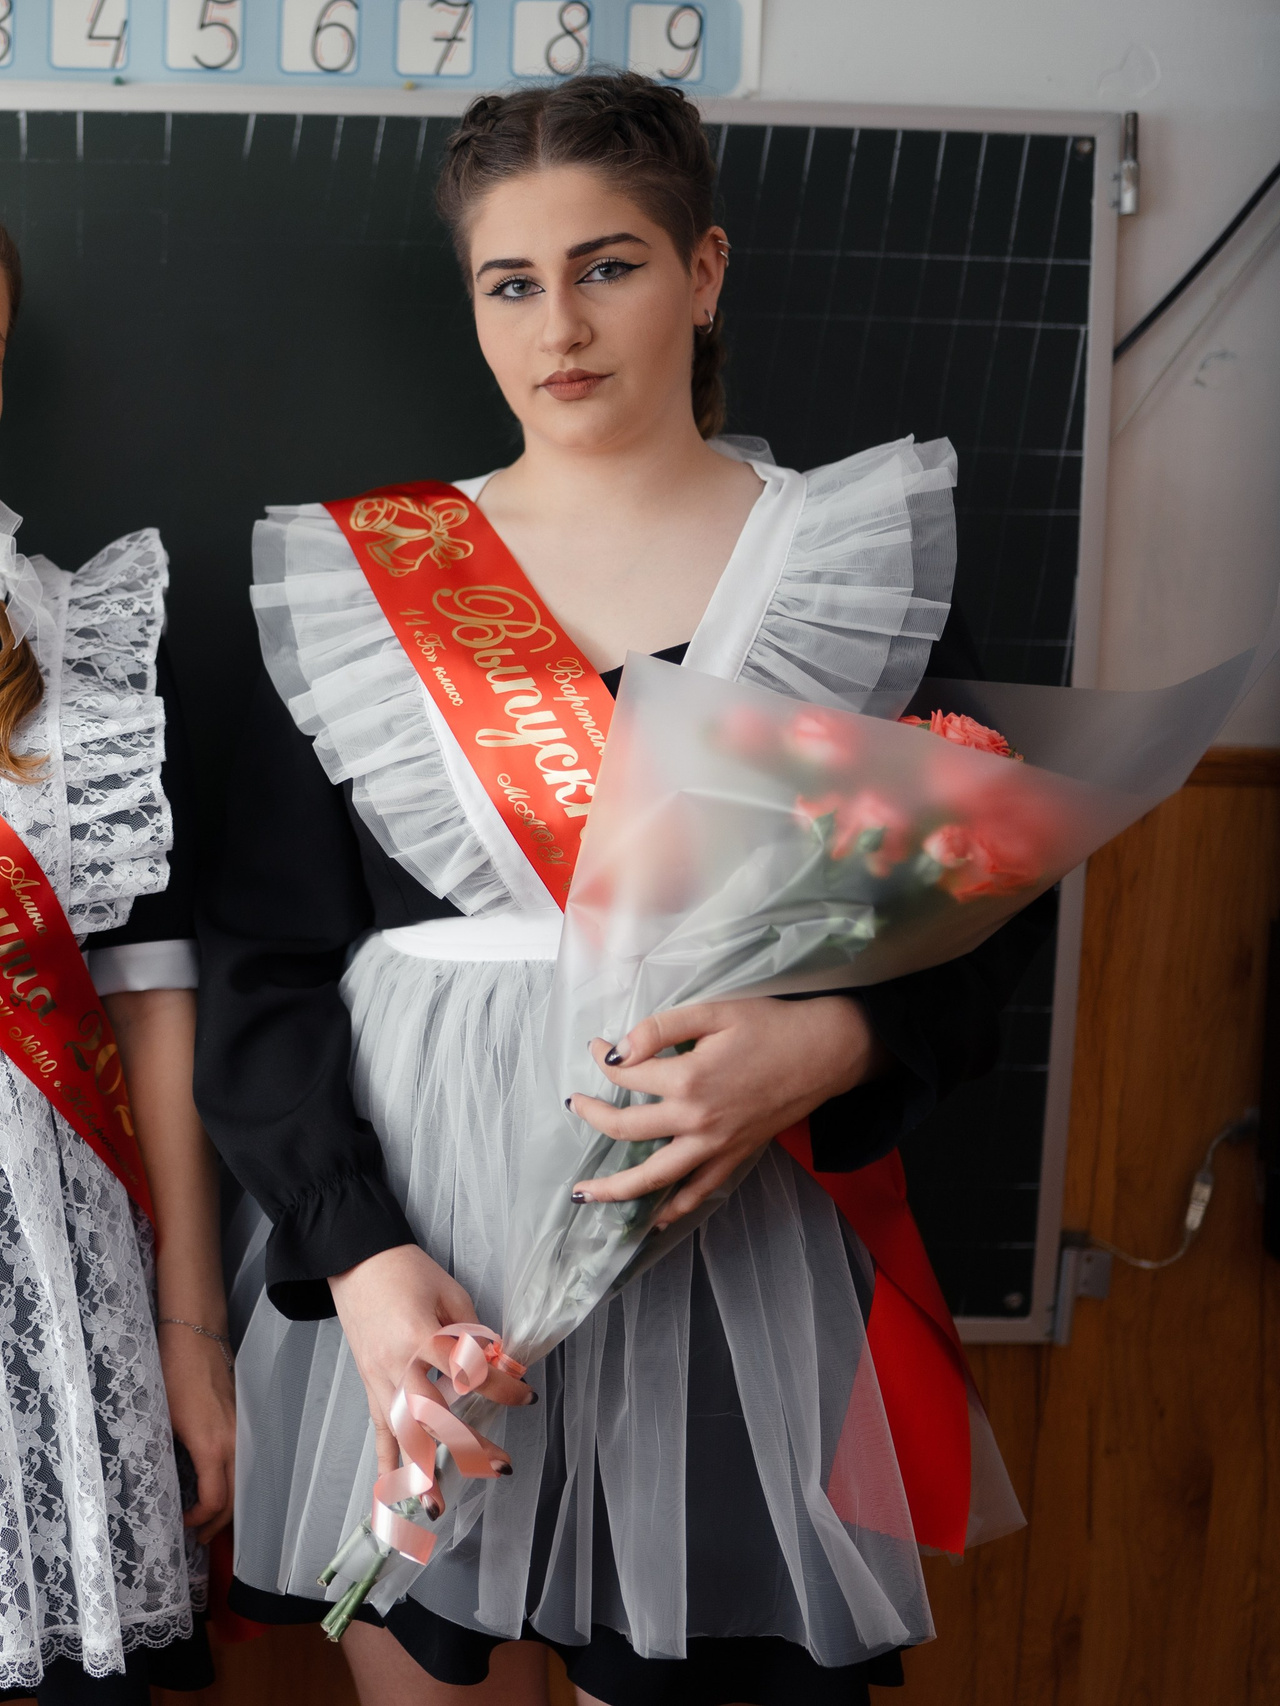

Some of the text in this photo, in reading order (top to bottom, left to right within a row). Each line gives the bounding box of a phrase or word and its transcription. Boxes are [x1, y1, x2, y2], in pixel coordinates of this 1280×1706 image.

[87, 0, 128, 68] 4
[193, 0, 239, 69] 5
[311, 0, 359, 73] 6
[430, 0, 472, 75] 7
[546, 2, 591, 75] 8
[659, 5, 703, 79] 9
[432, 666, 464, 706] класс
